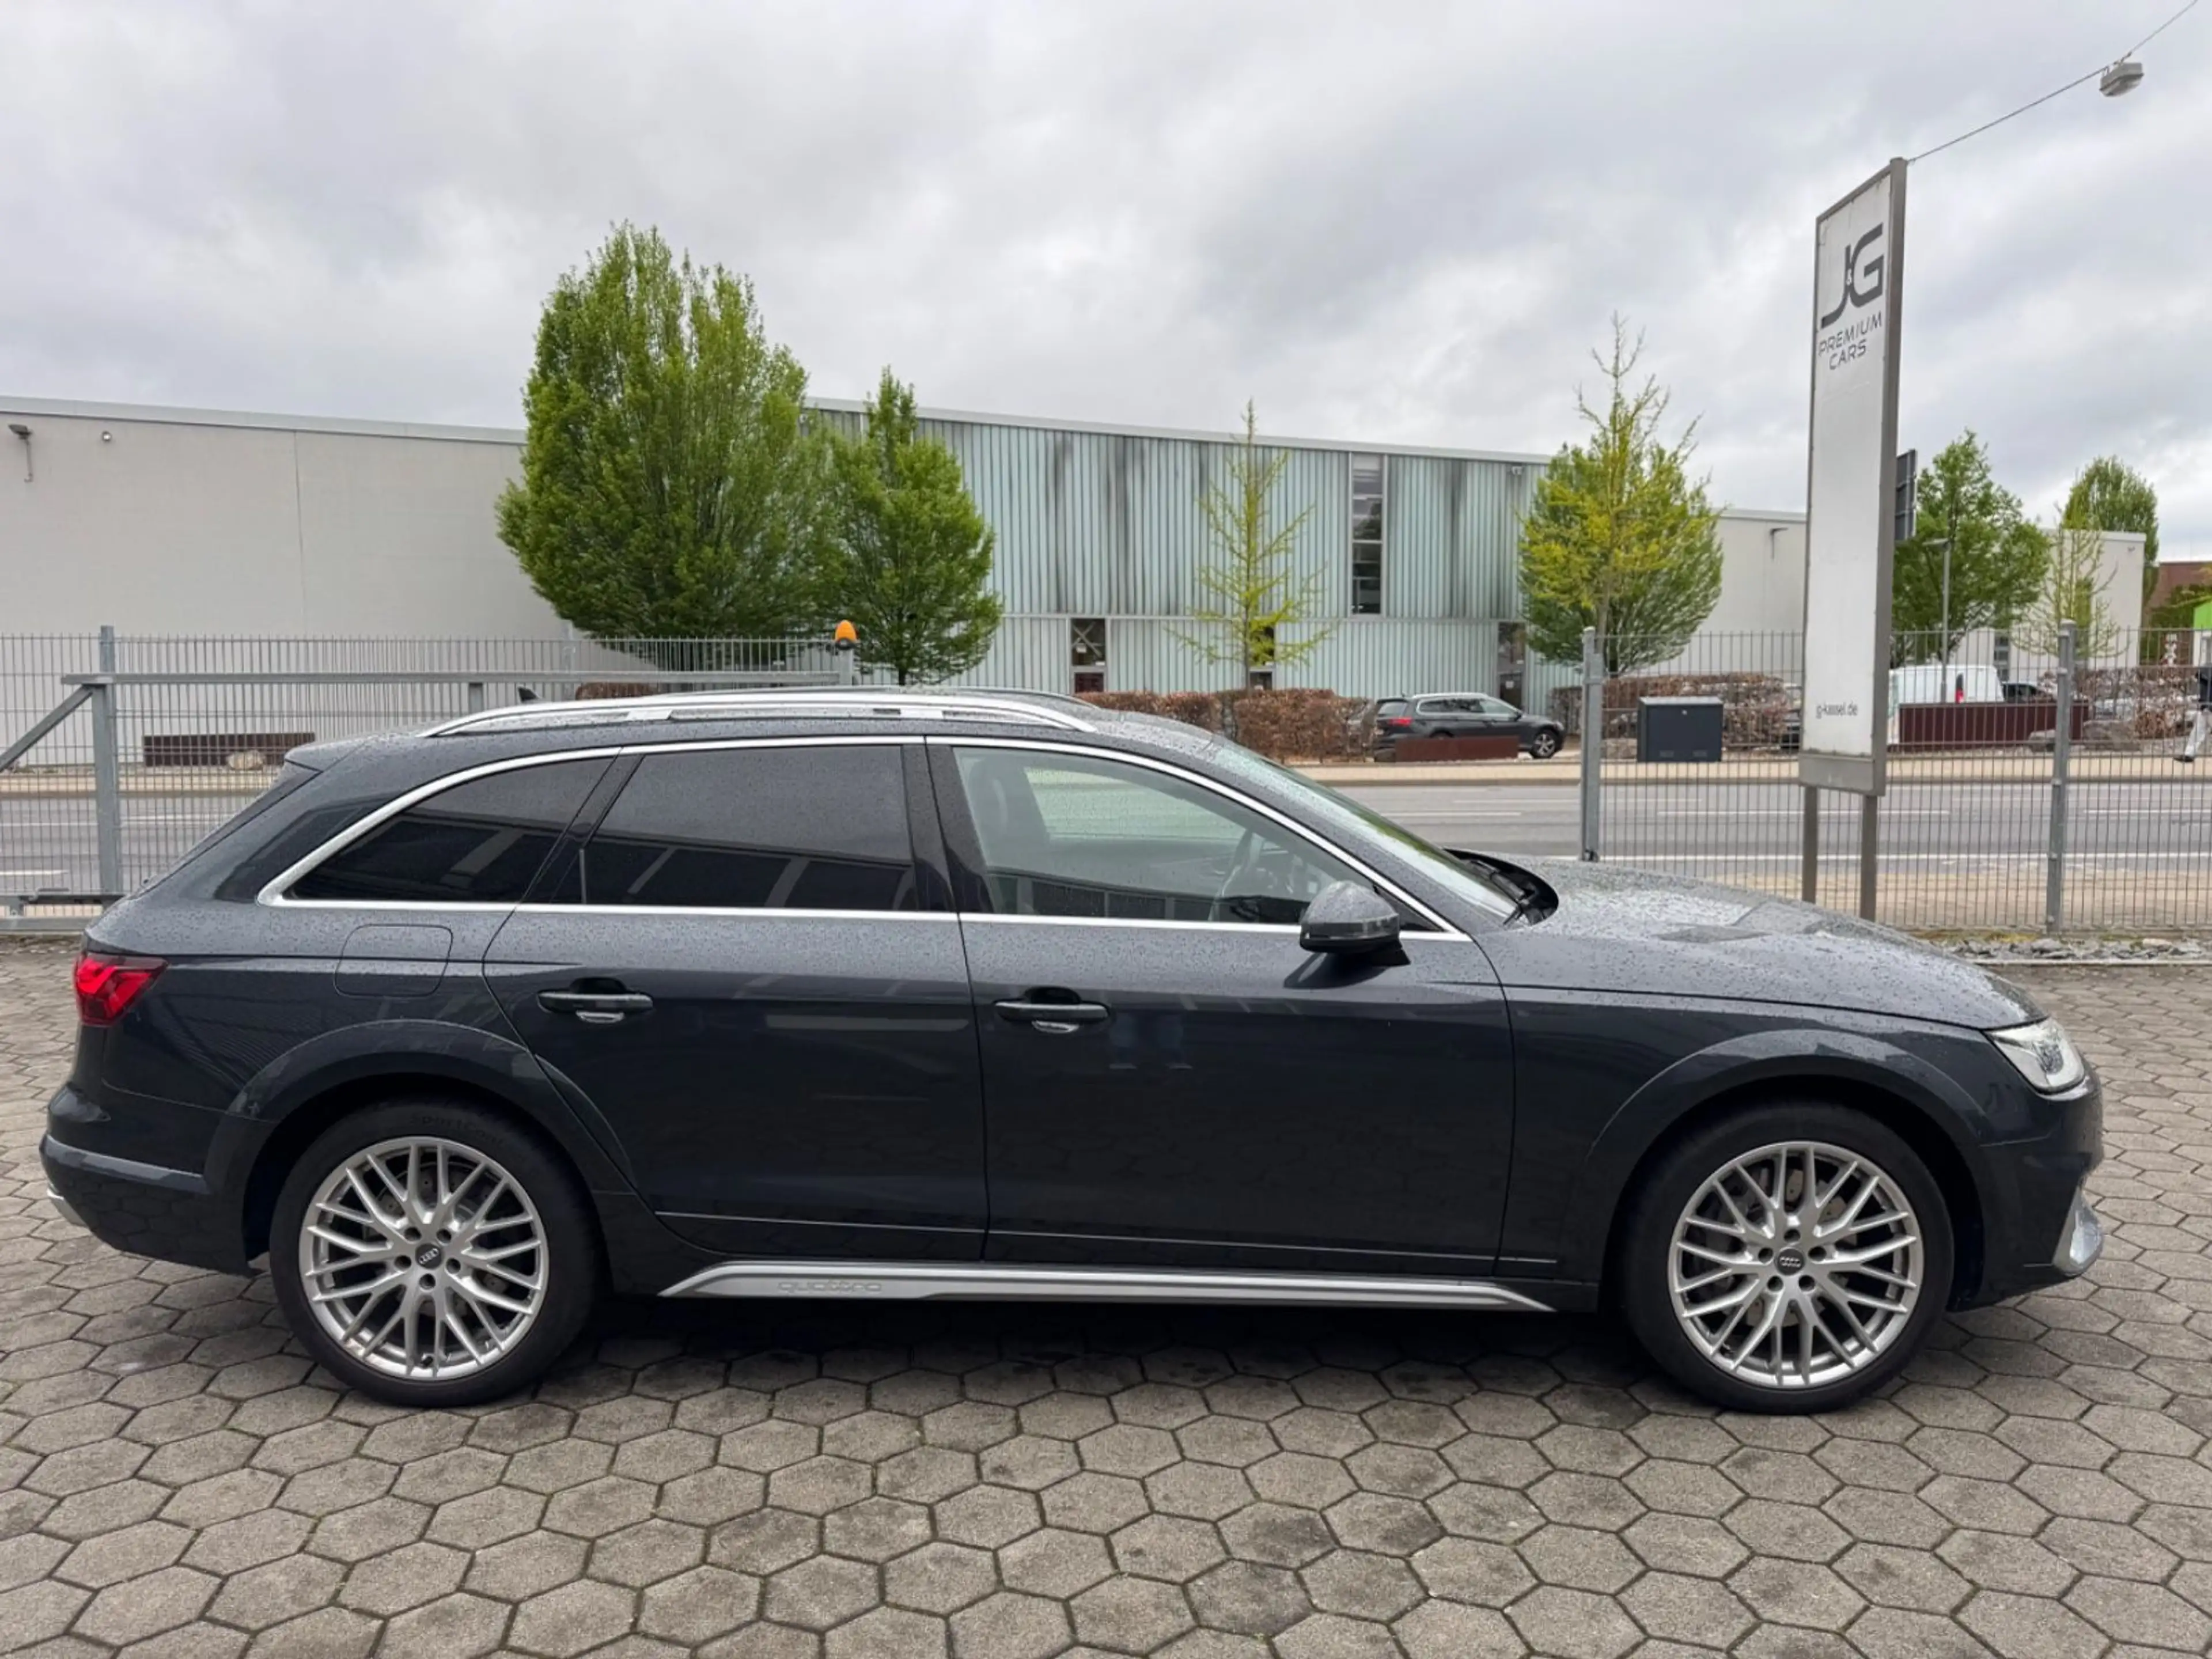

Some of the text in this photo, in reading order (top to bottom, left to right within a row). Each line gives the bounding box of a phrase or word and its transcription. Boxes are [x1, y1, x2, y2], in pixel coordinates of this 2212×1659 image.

[1819, 310, 1882, 357] PREMIUM
[1829, 339, 1866, 370] CARS
[778, 1279, 882, 1294] quattro
